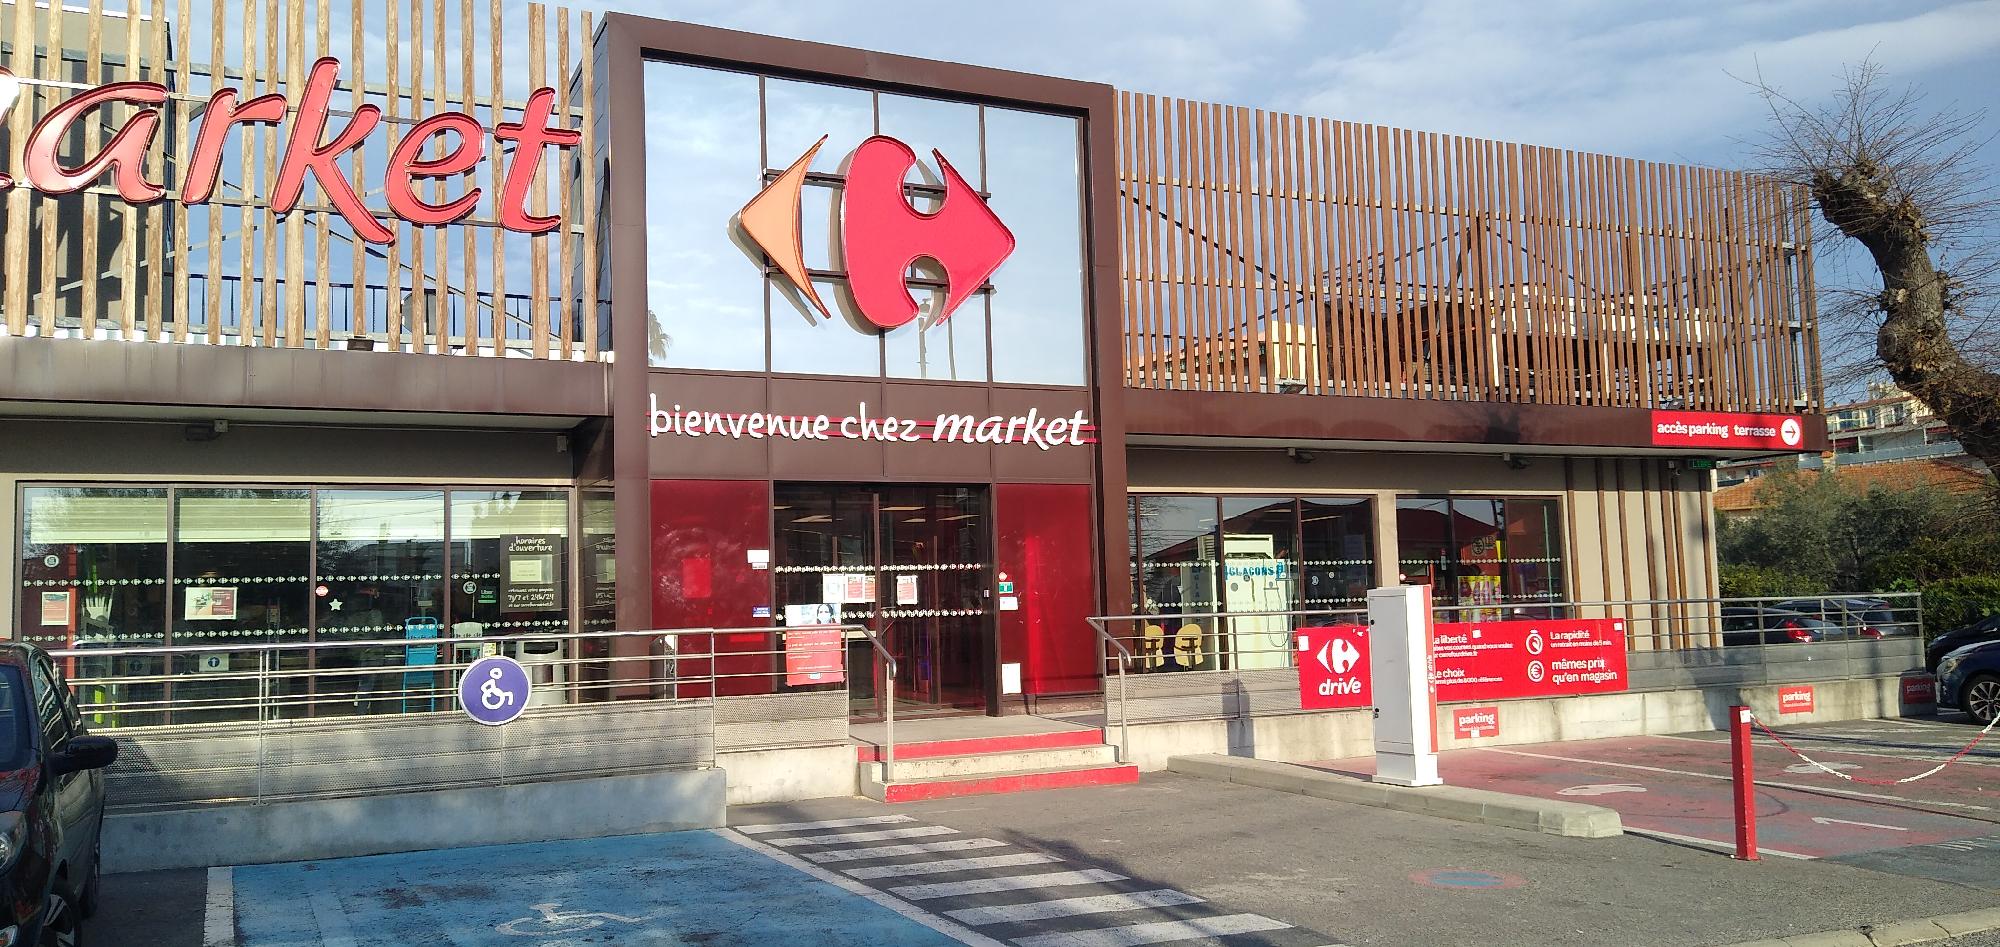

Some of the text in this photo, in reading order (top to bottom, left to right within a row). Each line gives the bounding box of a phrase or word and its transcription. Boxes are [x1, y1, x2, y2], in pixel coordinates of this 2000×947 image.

[0, 55, 583, 246] arket
[649, 392, 1090, 451] bienvenue chez market
[1656, 420, 1776, 439] accès parking terrasse
[515, 535, 547, 545] horaires
[508, 543, 553, 552] d'ouverture
[1440, 634, 1467, 644] liberté
[1550, 630, 1590, 641] La rapidité
[1551, 658, 1586, 670] mêmes
[1443, 668, 1465, 678] choix
[1552, 669, 1617, 685] qu'en magasin
[1318, 676, 1362, 696] drive
[1906, 683, 1931, 694] parking
[1782, 690, 1812, 702] parking
[1458, 712, 1495, 727] parking
